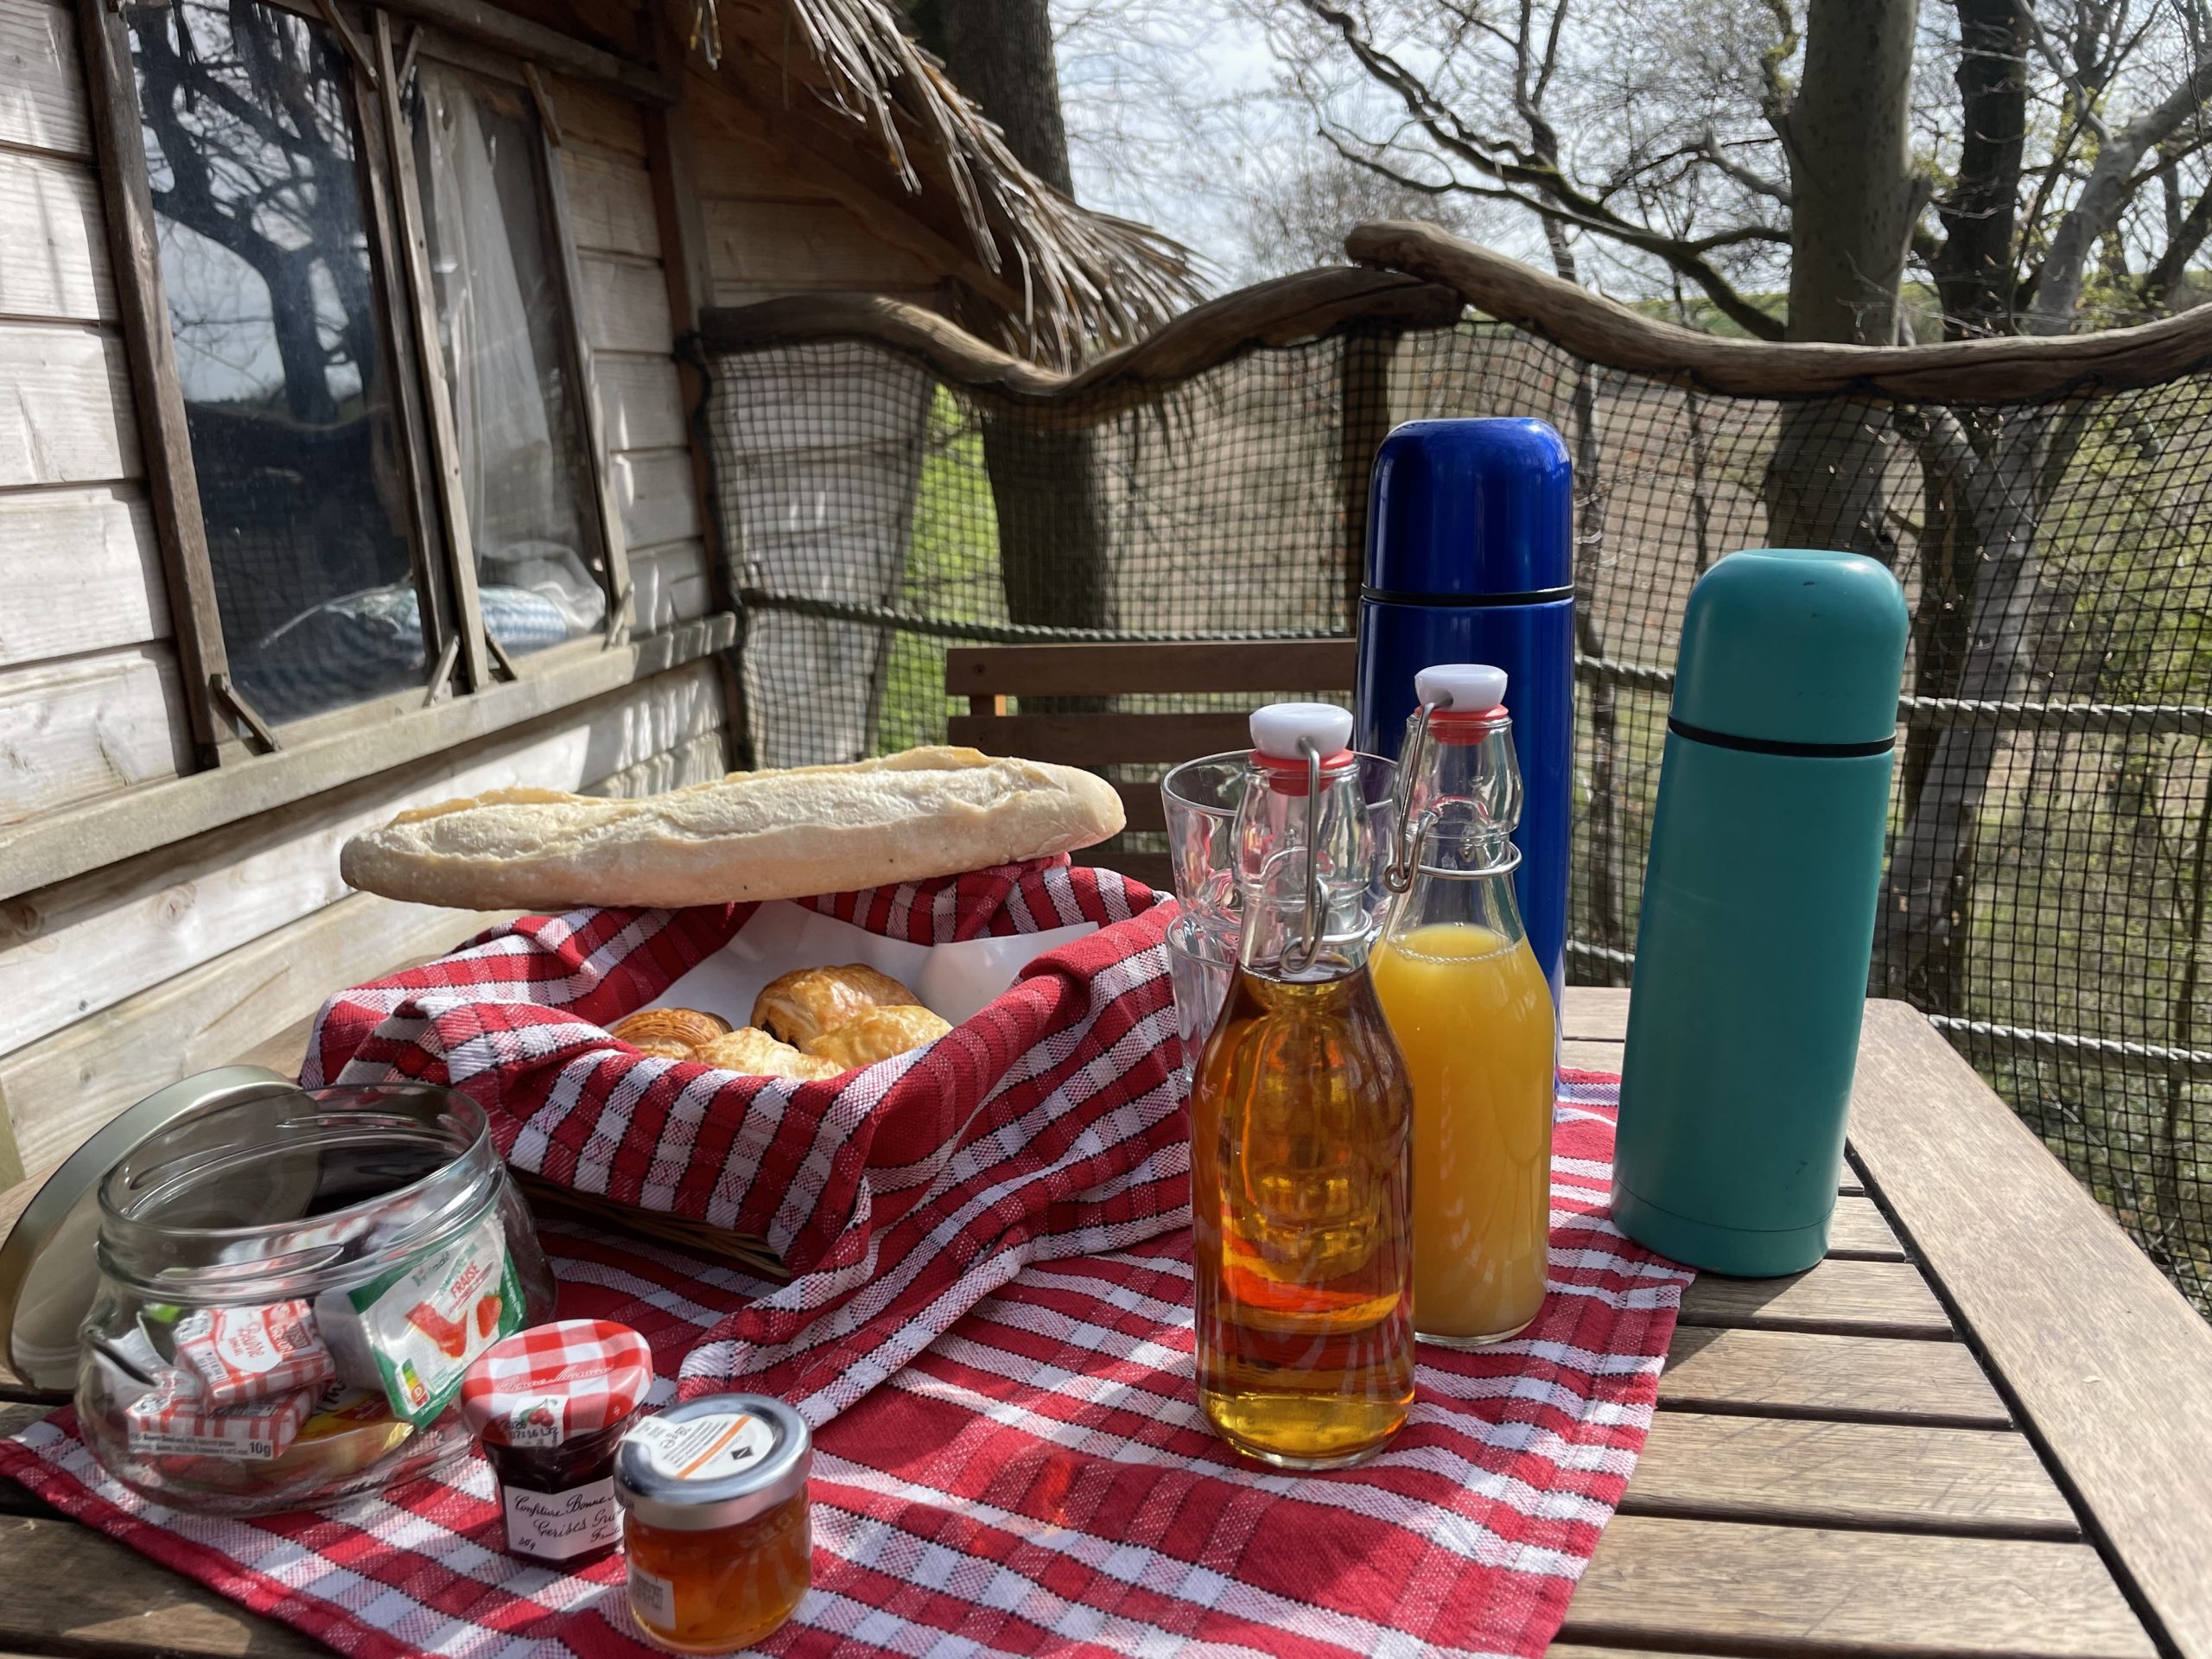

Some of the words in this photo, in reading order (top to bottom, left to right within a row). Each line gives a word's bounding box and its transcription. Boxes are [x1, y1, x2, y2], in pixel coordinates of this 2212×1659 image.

[451, 1261, 480, 1298] FRAISE
[249, 1441, 271, 1457] 10g
[514, 1495, 564, 1518] Confiture
[566, 1493, 607, 1513] Bonne
[533, 1518, 588, 1538] Cerises
